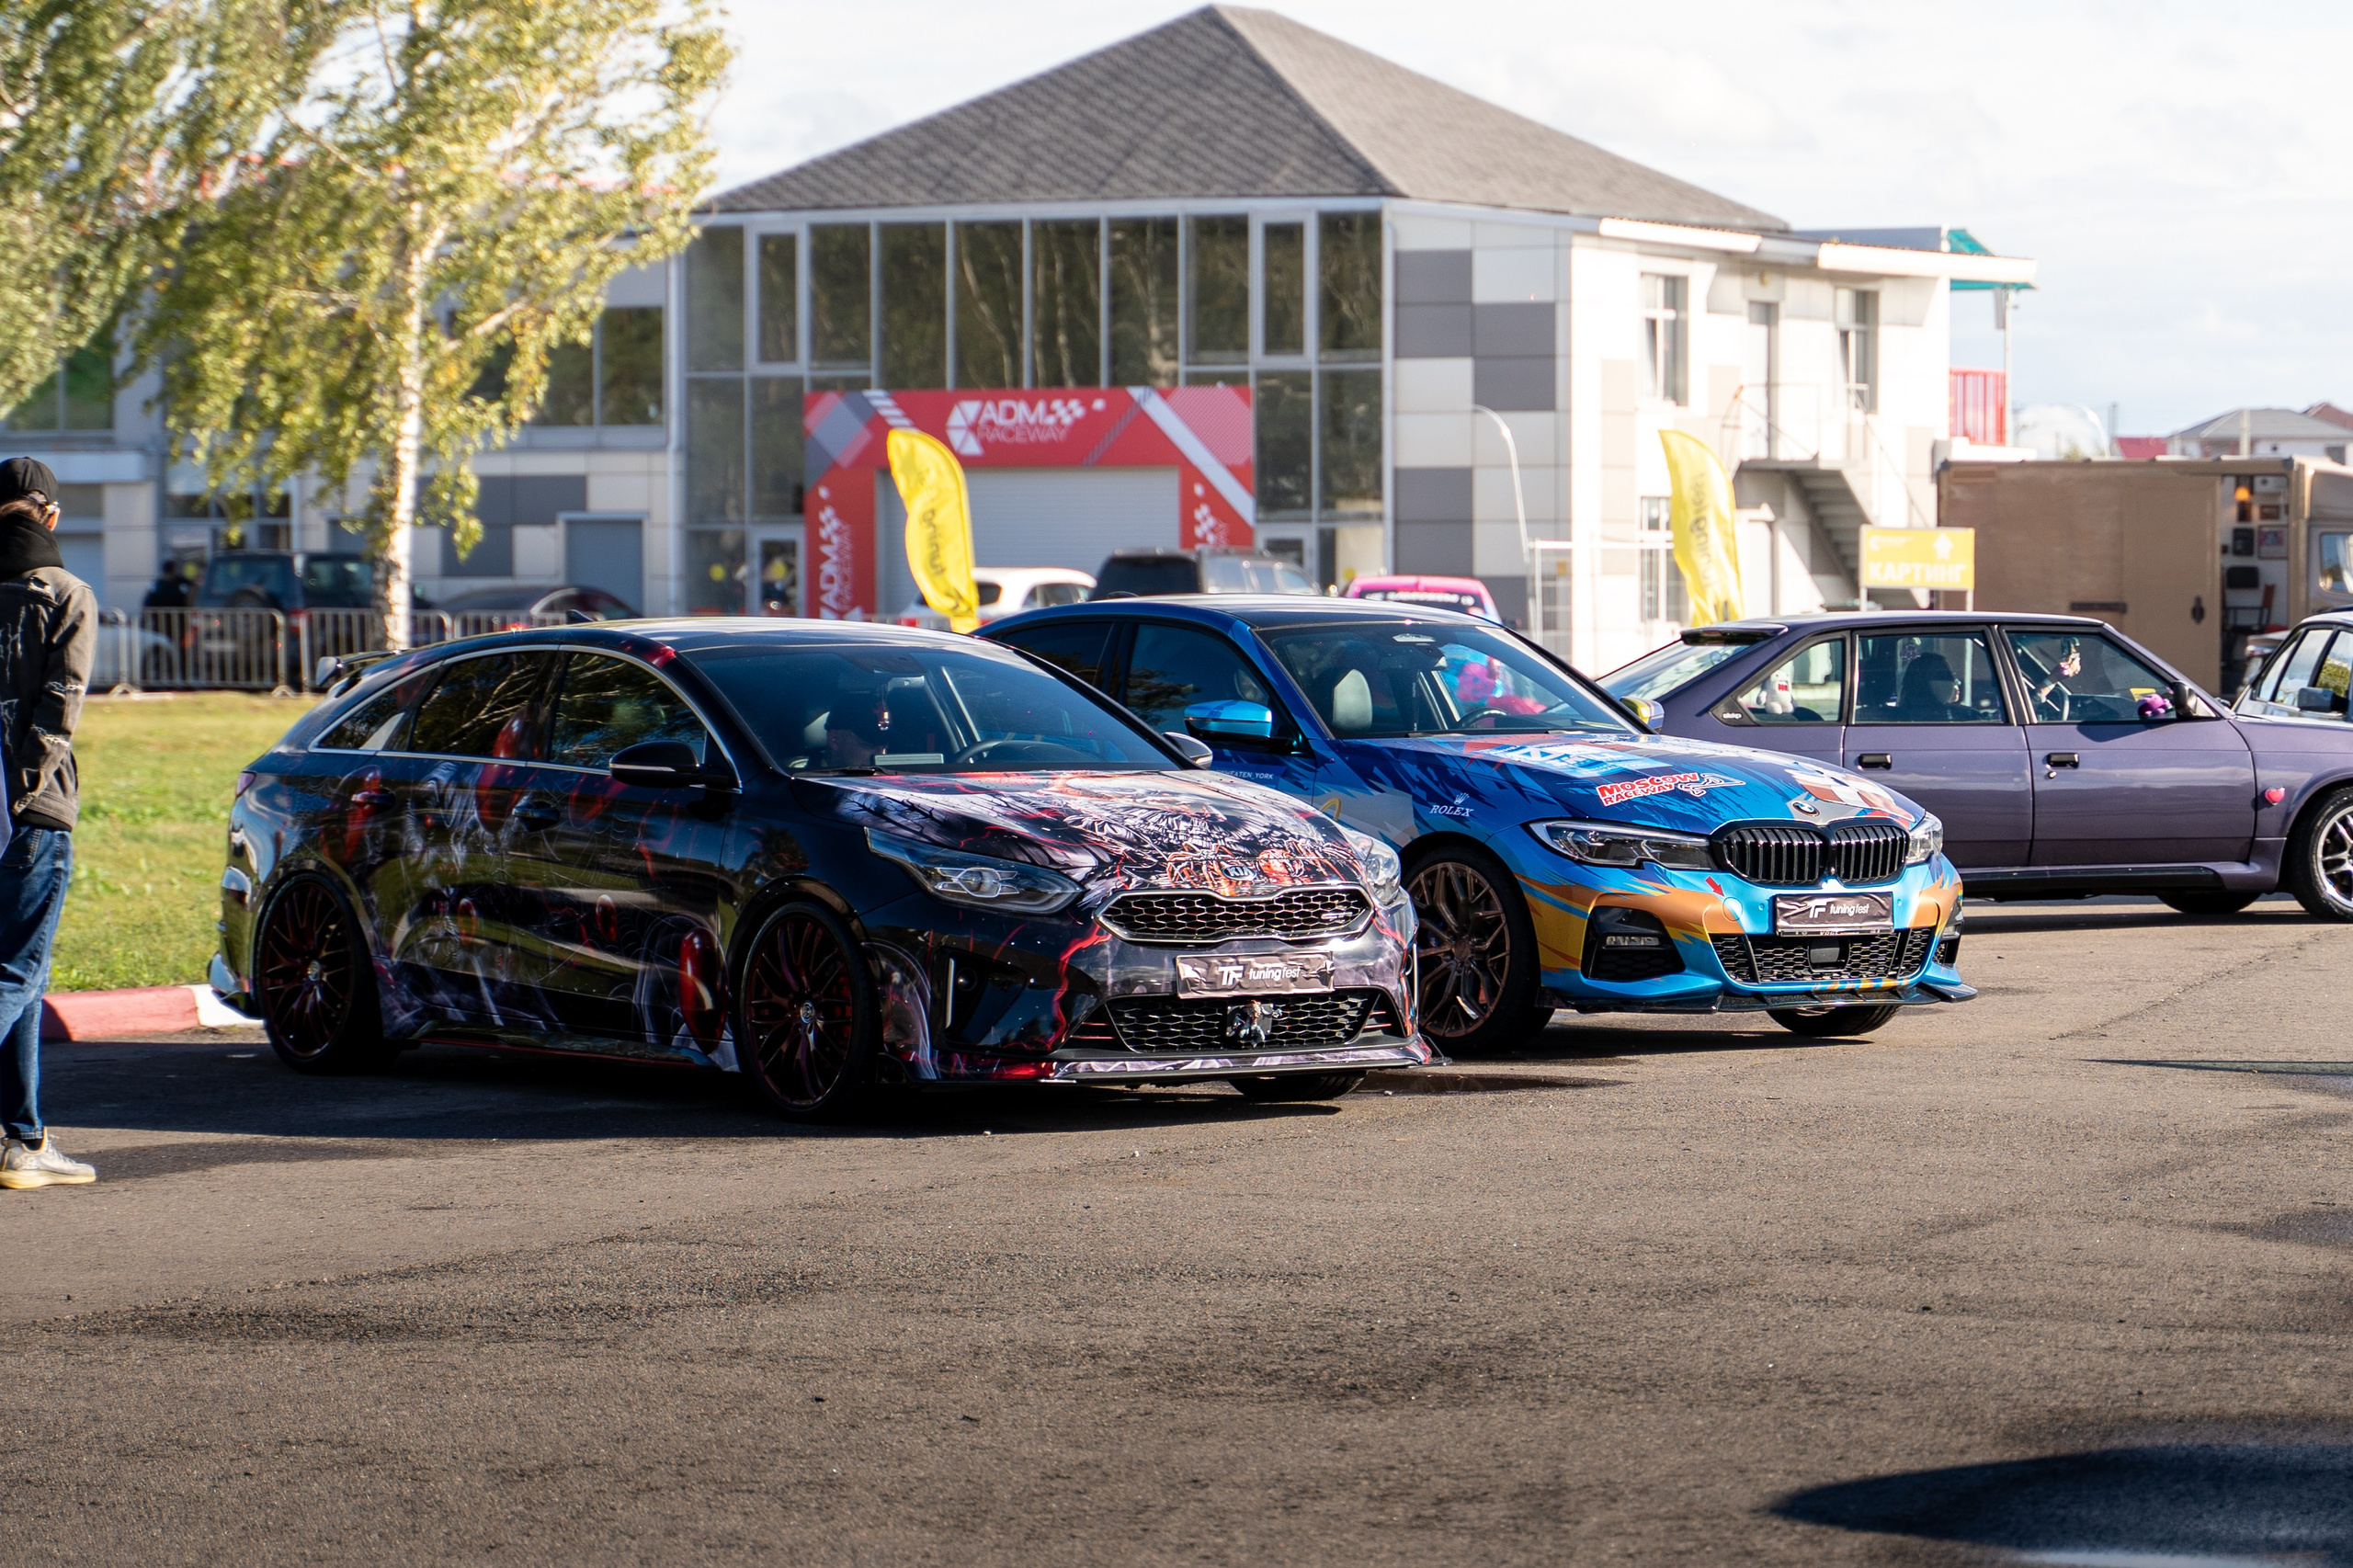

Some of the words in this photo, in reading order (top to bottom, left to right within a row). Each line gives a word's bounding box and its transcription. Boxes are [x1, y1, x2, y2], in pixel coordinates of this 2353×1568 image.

[978, 399, 1046, 426] ADM
[977, 425, 1068, 443] RACEWAY
[837, 523, 853, 610] RACEWAY
[1869, 562, 1967, 583] КАРТИНГ
[1597, 773, 1699, 798] MOSCOW
[1603, 783, 1673, 805] RACEWAY
[1429, 805, 1474, 817] ROLEX
[1227, 865, 1255, 878] KIA
